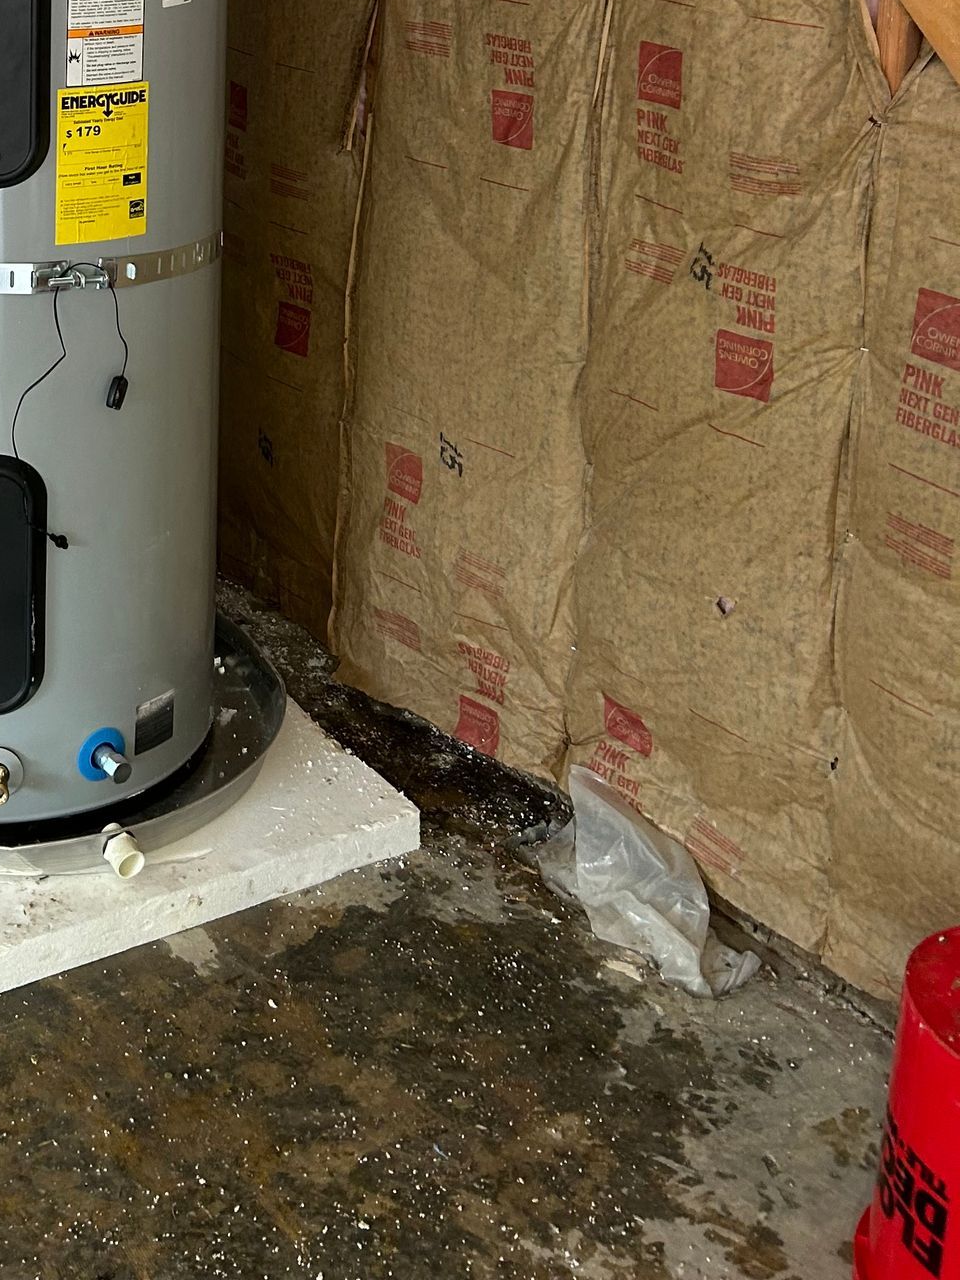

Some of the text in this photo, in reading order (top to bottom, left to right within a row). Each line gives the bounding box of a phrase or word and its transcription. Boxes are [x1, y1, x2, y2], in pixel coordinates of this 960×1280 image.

[504, 68, 534, 88] PINK
[61, 90, 146, 112] ENERGYGUIDE
[66, 126, 101, 139] $ 179
[637, 108, 668, 133] PINK
[638, 128, 661, 147] NEXT
[638, 146, 685, 175] FIBERGLAS
[718, 262, 776, 293] FIBERGLAS
[721, 283, 775, 311] NEXT GEN
[737, 305, 775, 334] PINK
[720, 339, 768, 361] CORNING
[720, 350, 759, 369] OWENS
[903, 363, 945, 399] PINK
[900, 387, 960, 427] NEXT GEN
[384, 496, 407, 524] PINK
[595, 741, 631, 773] PINK
[588, 756, 641, 797] NEXT GEN
